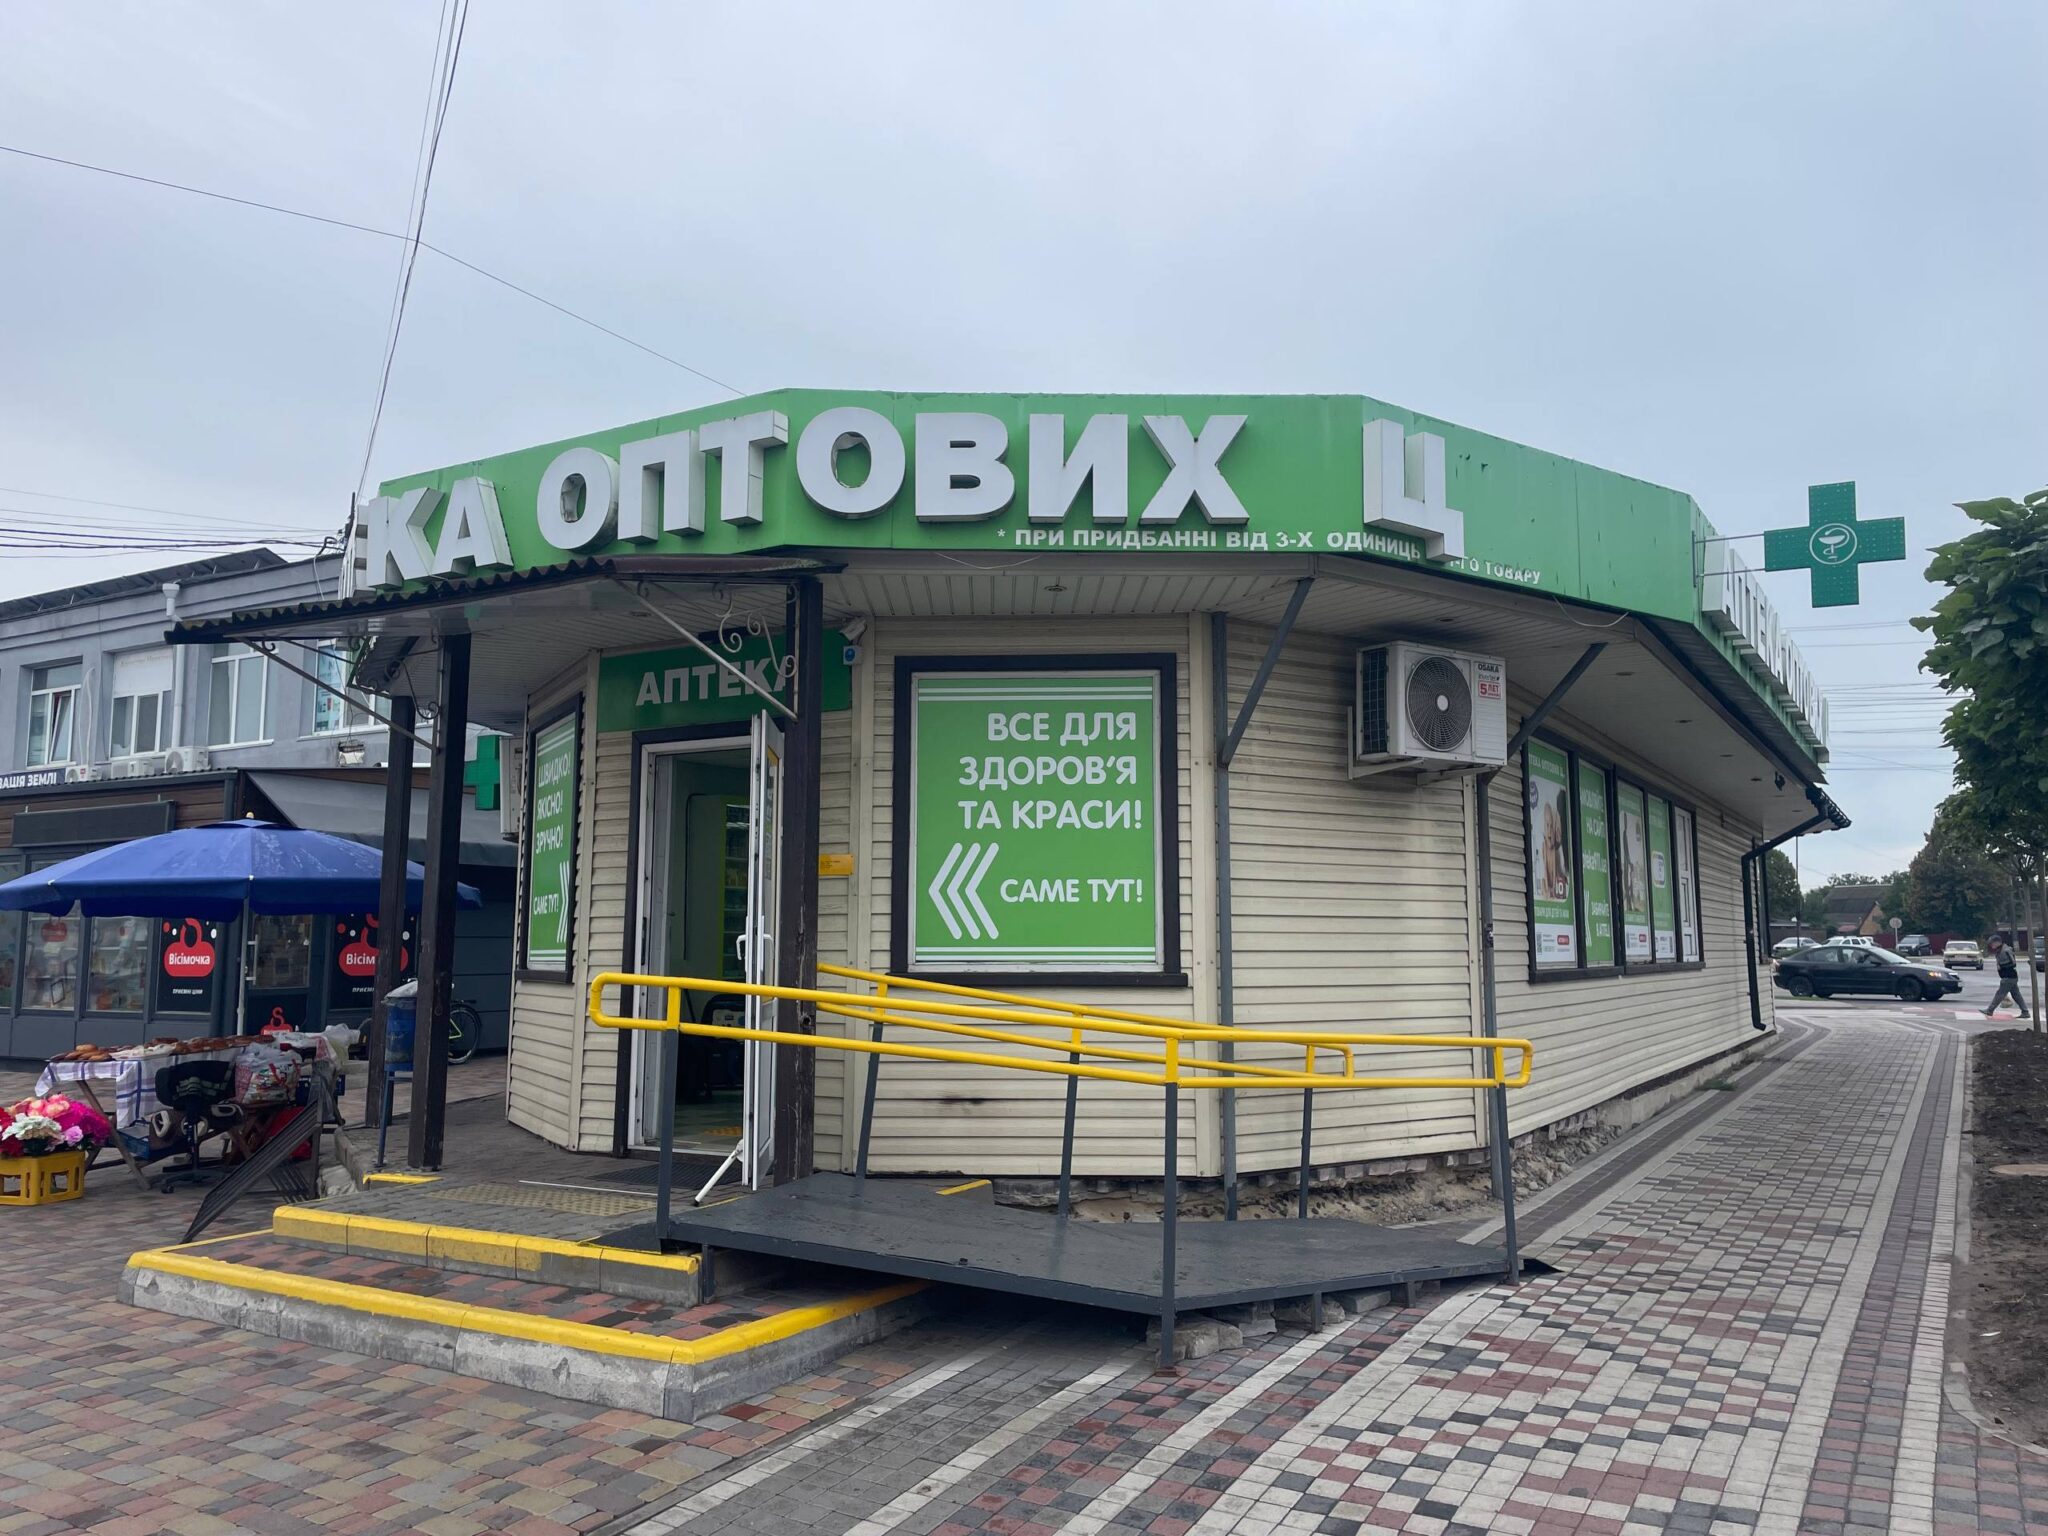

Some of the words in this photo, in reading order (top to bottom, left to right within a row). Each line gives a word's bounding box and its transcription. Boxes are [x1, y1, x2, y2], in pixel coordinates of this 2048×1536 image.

[537, 406, 1249, 553] ОПТОВИХ
[1363, 418, 1464, 561] Ц
[1015, 530, 1065, 546] ПРИ
[1073, 530, 1216, 549] ПРИДБАННІ
[1226, 532, 1268, 551] ВІД
[1327, 532, 1421, 560] ОДИНИЦЬ
[1485, 560, 1541, 585] ТОВАРУ
[1480, 683, 1488, 695] 5
[987, 712, 1050, 741] ВСЕ
[1060, 712, 1136, 746] ДЛЯ
[27, 771, 57, 787] ЗЕМЛІ
[539, 753, 571, 787] ШВИДКО!
[958, 755, 1137, 791] ЗДОРОВ'Я
[537, 793, 563, 820] ЯКІСНО!
[958, 800, 1002, 829] ТА
[1012, 800, 1142, 829] КРАСИ!
[536, 826, 564, 854] ЗРУЧНО!
[534, 895, 547, 915] САМЕ
[548, 893, 559, 913] ТУТ!
[1000, 879, 1080, 903] САМЕ
[1087, 879, 1142, 903] ТУТ!
[168, 952, 211, 965] Вісімочка
[346, 952, 376, 965] Вісім
